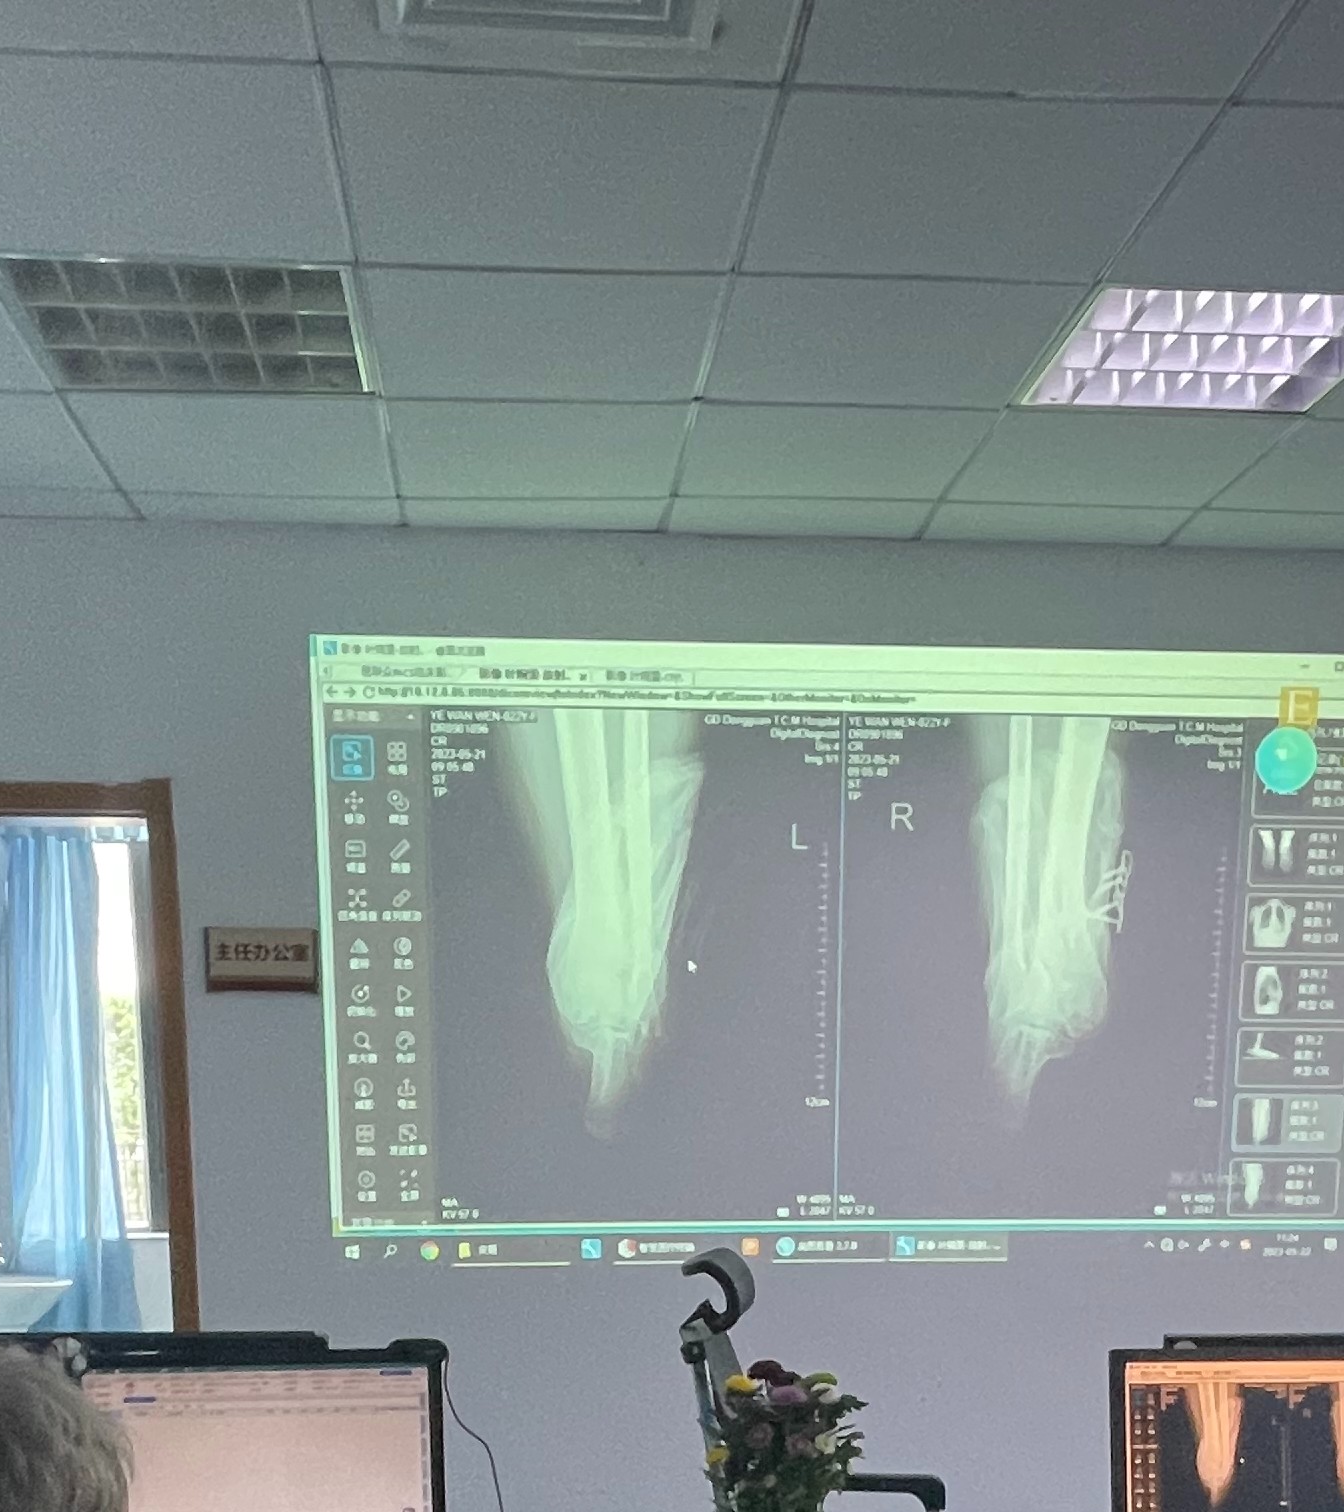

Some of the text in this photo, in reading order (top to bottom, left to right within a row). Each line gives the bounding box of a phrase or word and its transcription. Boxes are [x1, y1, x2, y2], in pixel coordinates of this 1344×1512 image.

[890, 802, 914, 831] R
[791, 823, 808, 850] L
[215, 943, 309, 961] 主任办公室
